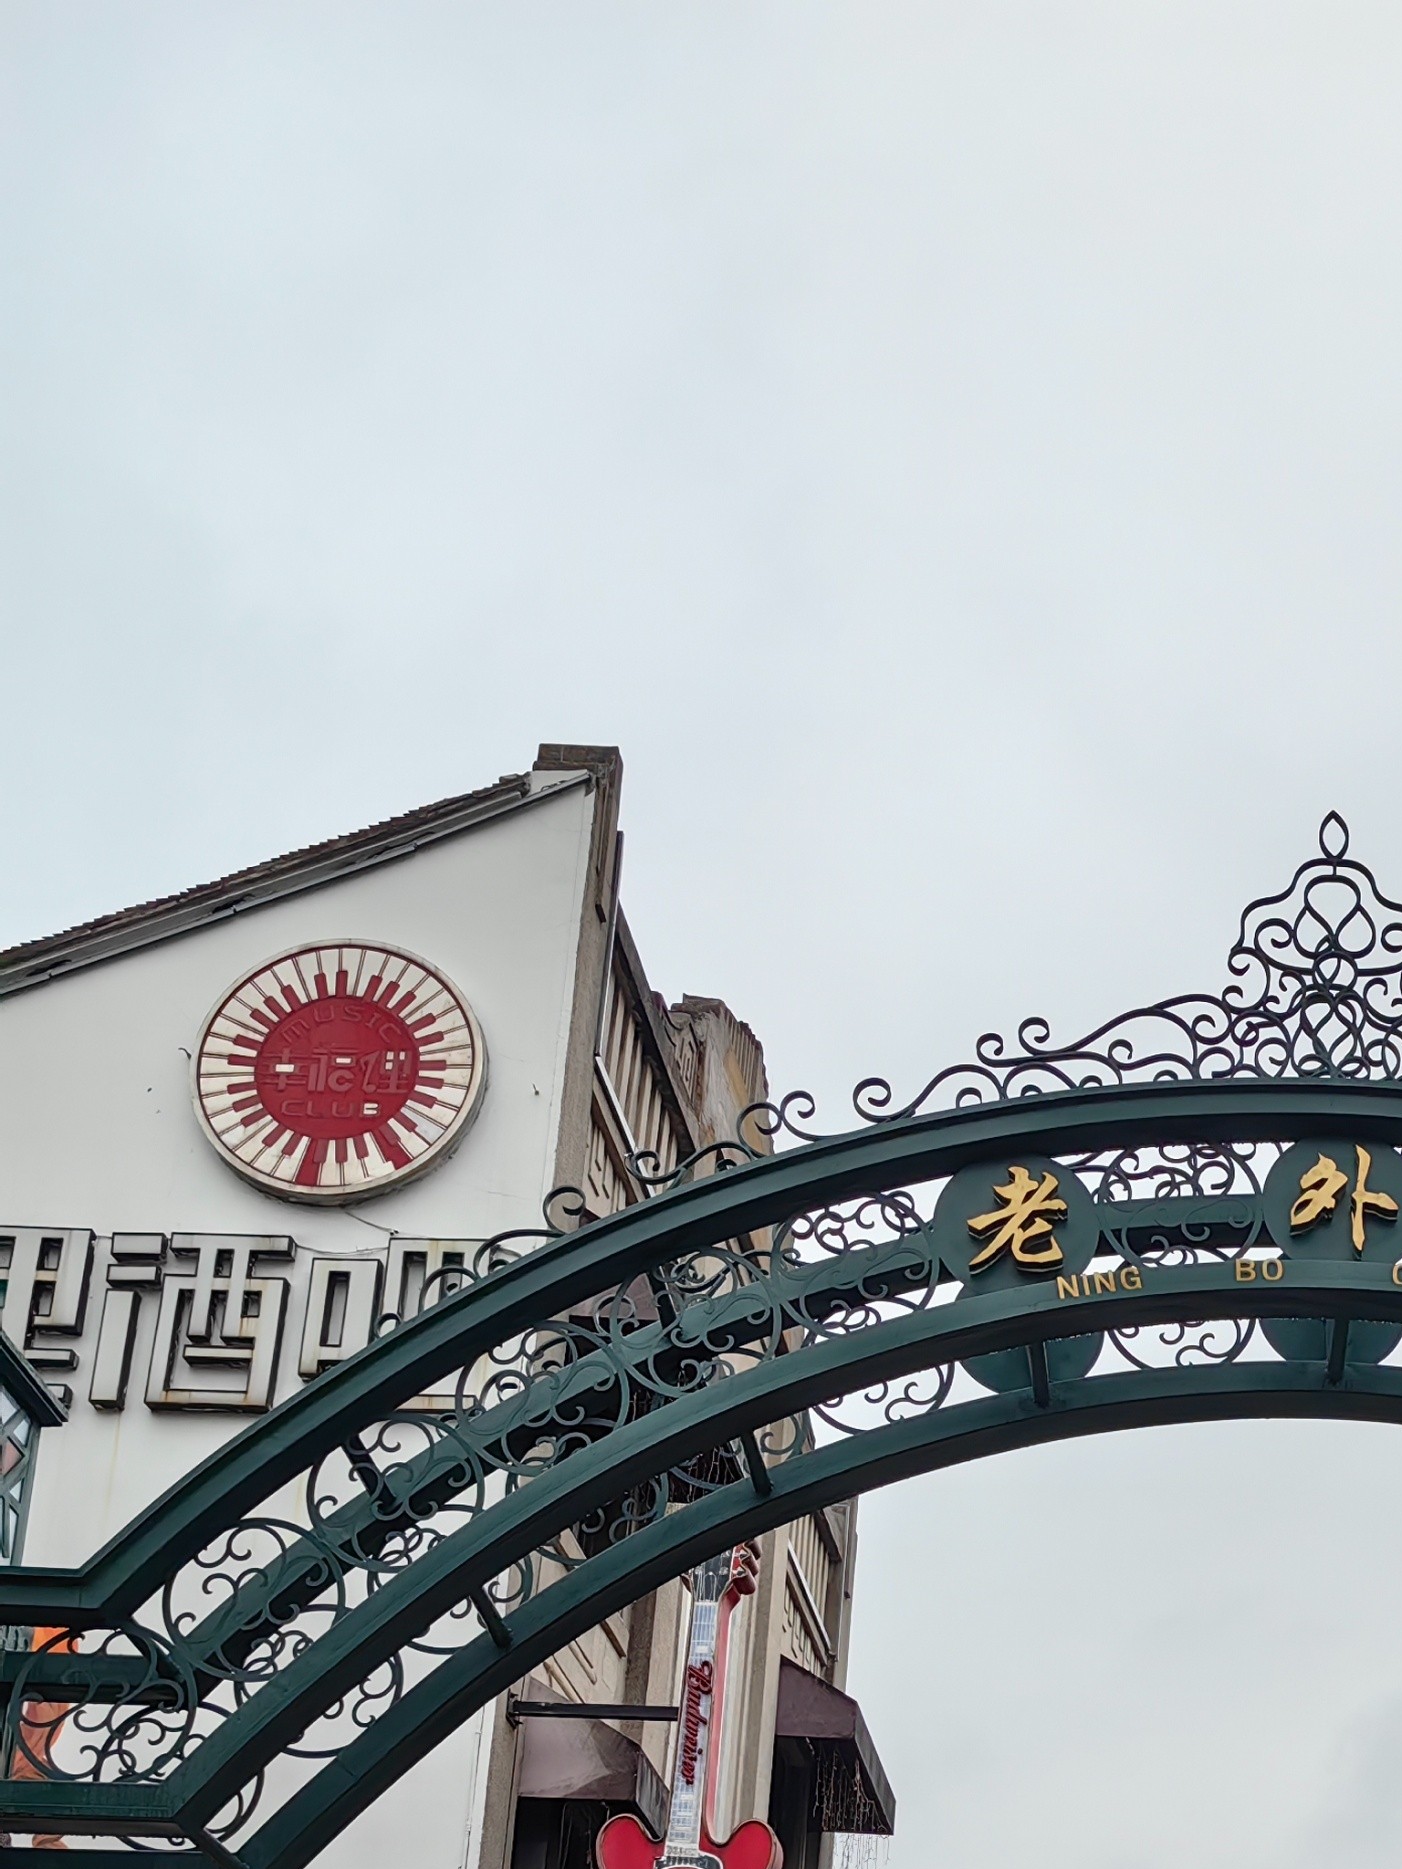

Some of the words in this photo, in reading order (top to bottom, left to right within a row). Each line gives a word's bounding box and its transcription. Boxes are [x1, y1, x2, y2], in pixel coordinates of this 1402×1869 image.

[282, 1004, 402, 1044] MUSIC
[281, 1099, 382, 1119] CLUB
[1056, 1266, 1143, 1299] NING
[1235, 1258, 1284, 1282] BO
